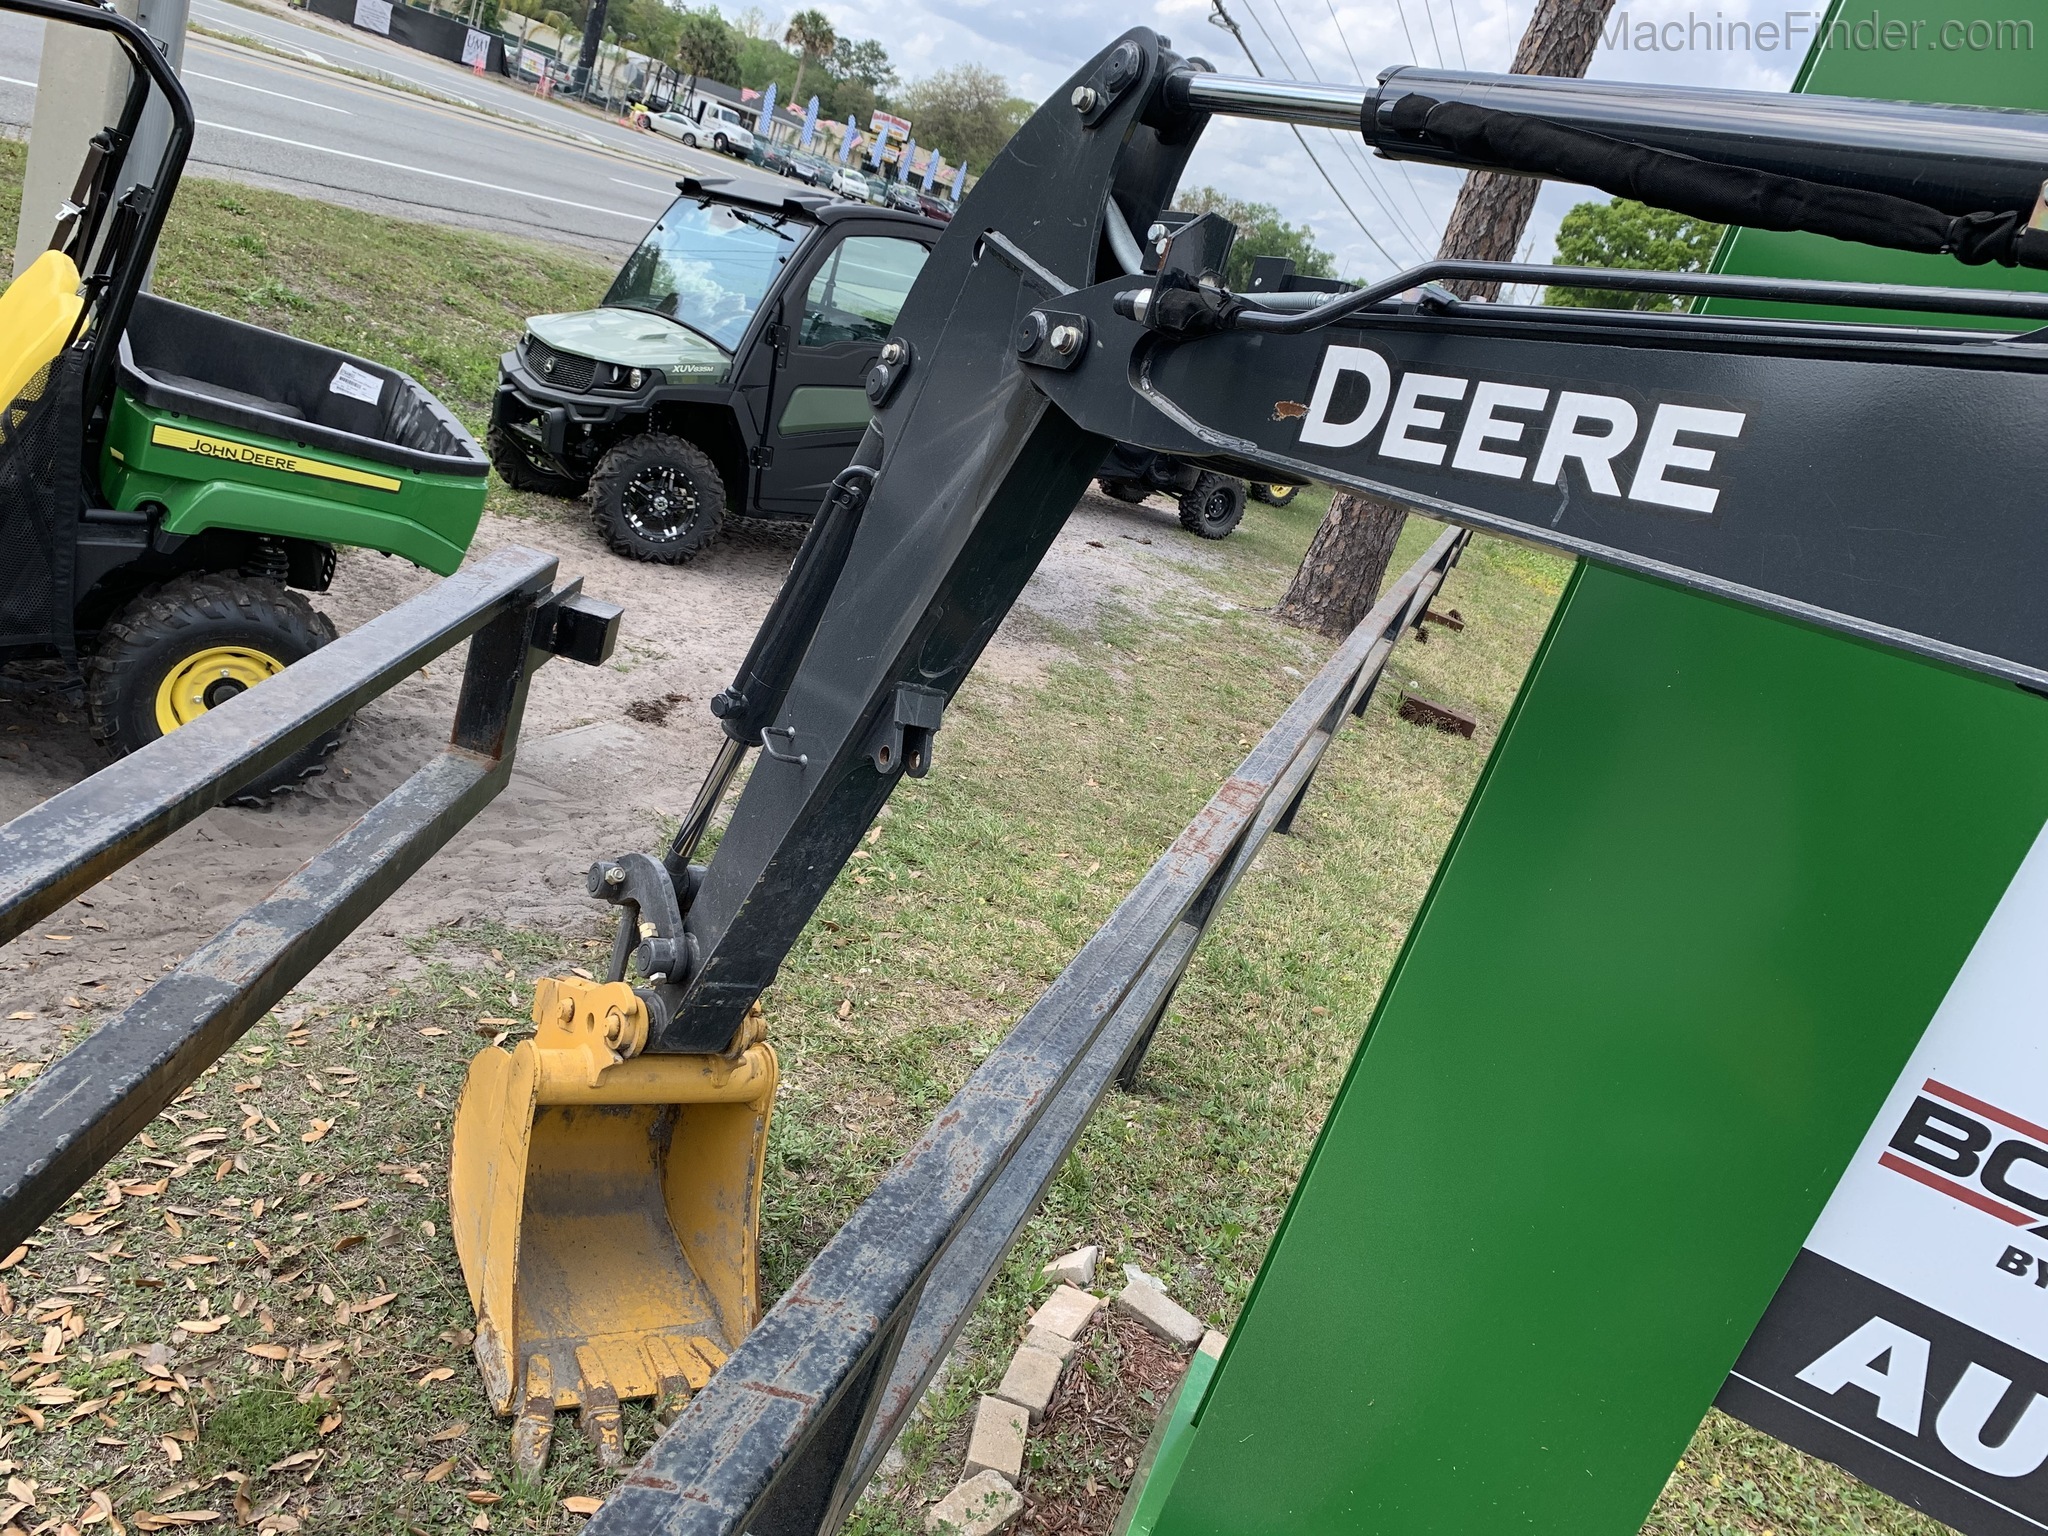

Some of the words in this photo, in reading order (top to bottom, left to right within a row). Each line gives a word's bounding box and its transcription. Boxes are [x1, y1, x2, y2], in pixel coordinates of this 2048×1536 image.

[672, 365, 714, 373] XUV835M
[189, 440, 237, 460] JOHN
[241, 450, 297, 471] DEERE
[1299, 344, 1746, 513] DEERE
[1888, 1095, 2048, 1240] BO
